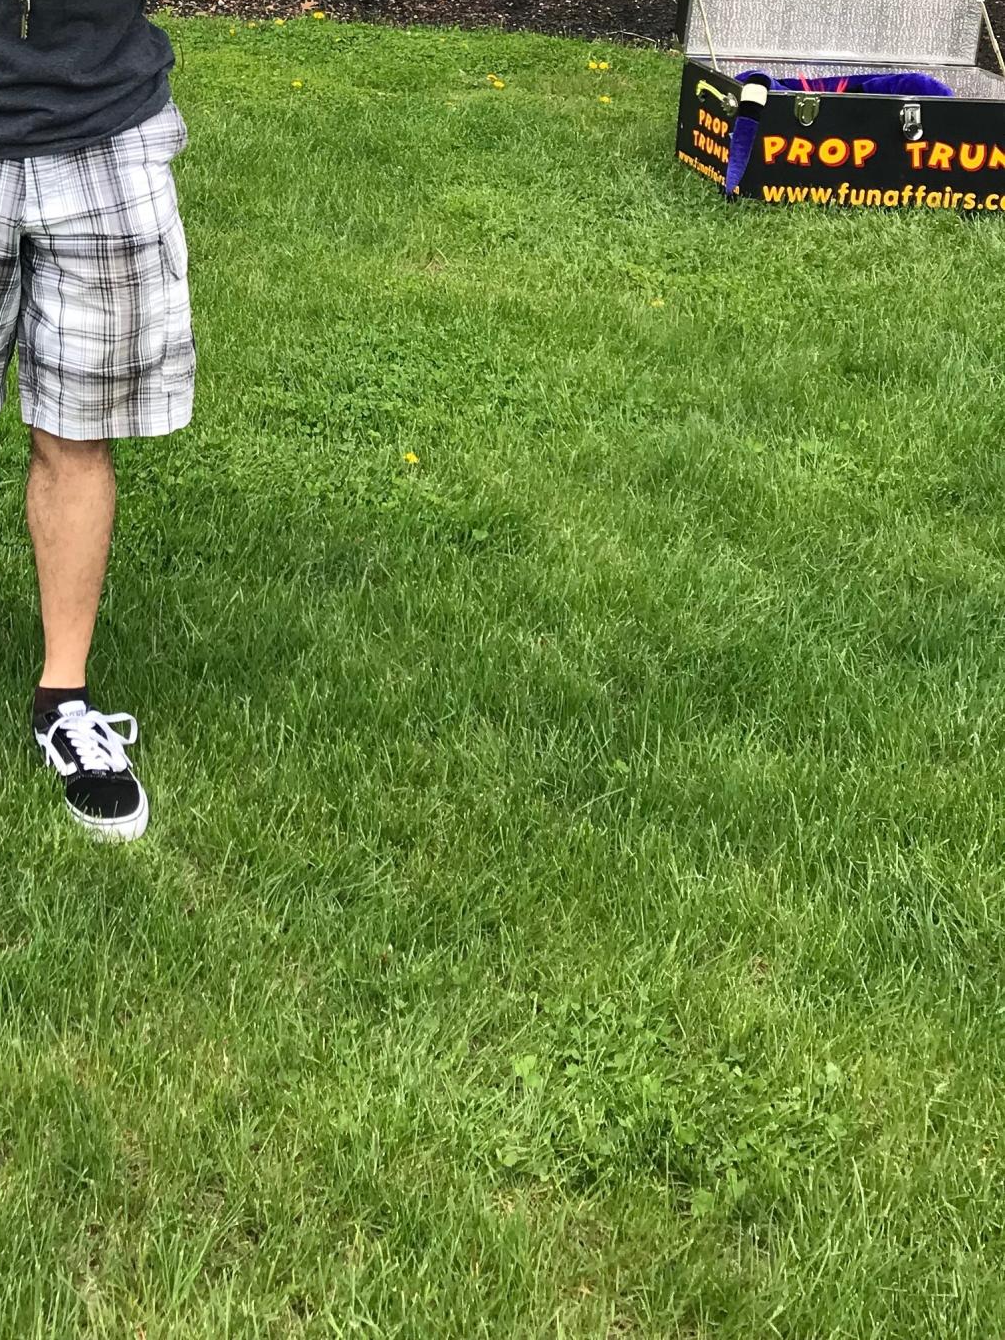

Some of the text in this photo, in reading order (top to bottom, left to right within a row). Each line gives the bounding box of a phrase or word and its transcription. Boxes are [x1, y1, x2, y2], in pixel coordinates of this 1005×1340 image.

[698, 108, 729, 138] PROP
[692, 129, 730, 164] TRUNK
[763, 135, 878, 168] PROP
